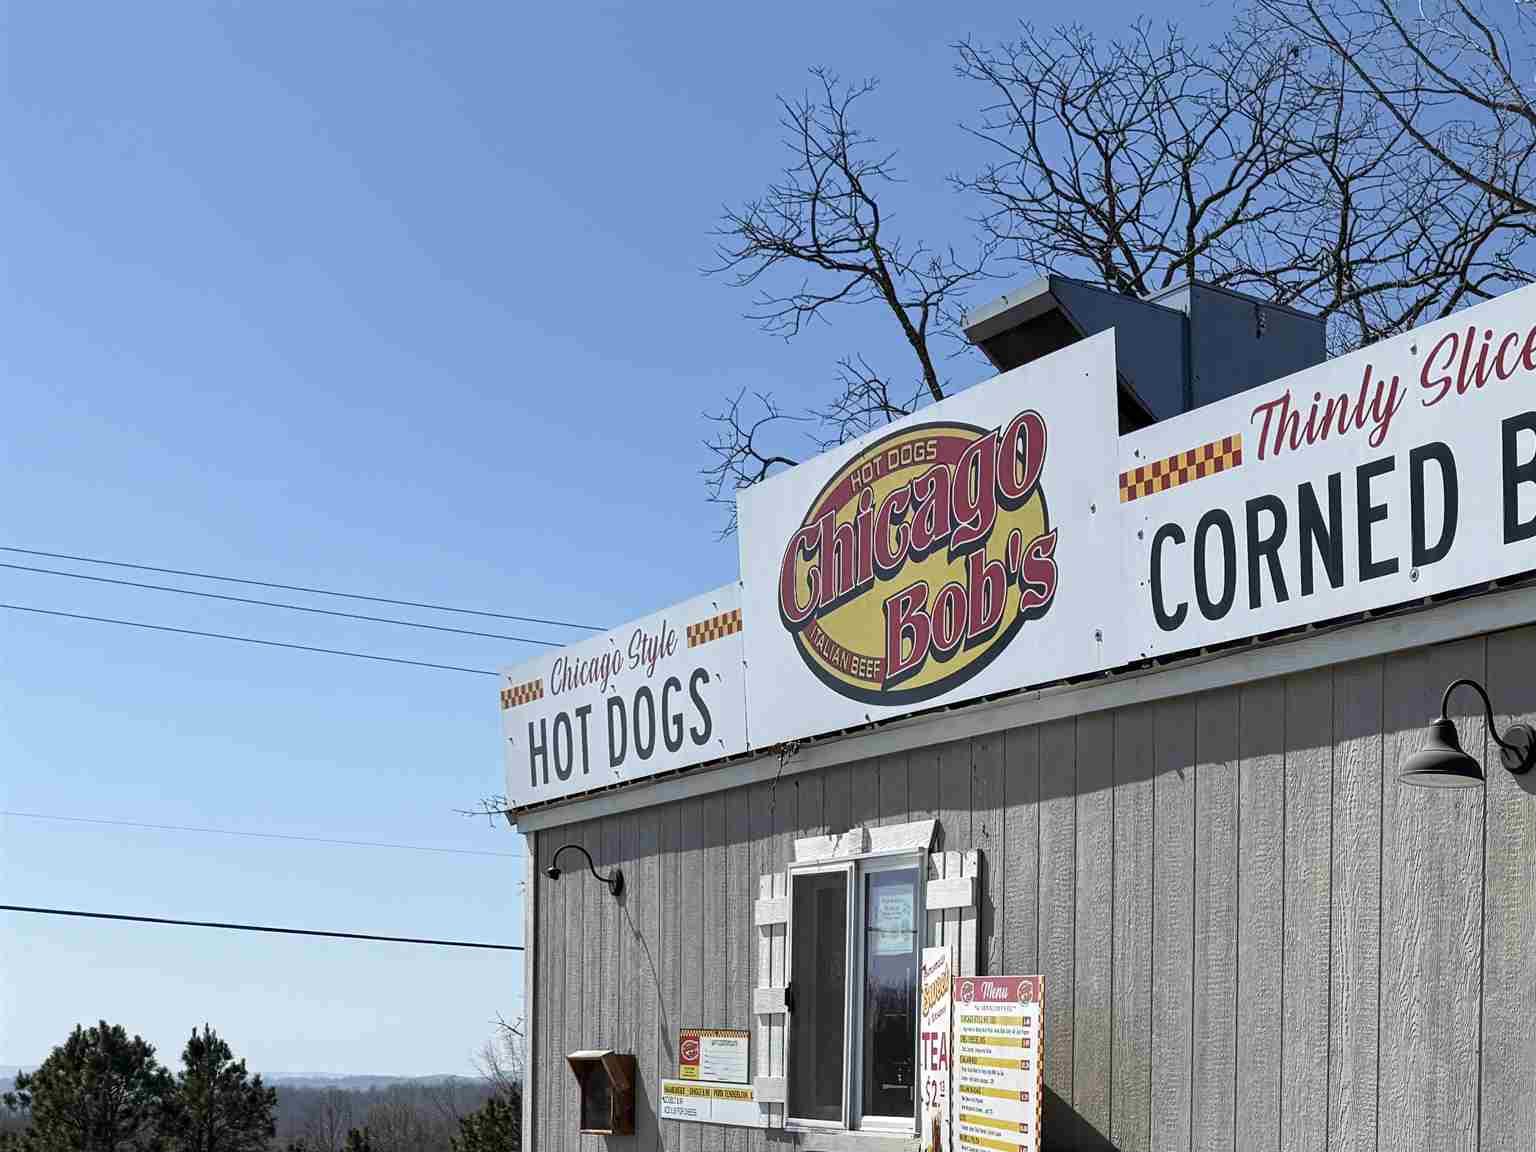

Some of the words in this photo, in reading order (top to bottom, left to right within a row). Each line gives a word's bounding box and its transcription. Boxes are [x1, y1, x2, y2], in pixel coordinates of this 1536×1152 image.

[1251, 364, 1407, 462] Thinly
[850, 458, 886, 492] HOT
[887, 439, 939, 469] DOGS
[778, 408, 1048, 632] Chicago
[1149, 440, 1459, 633] CORNED
[811, 625, 849, 671] ITALIAN
[850, 656, 881, 679] BEEF
[881, 528, 1059, 692] Bob's
[550, 639, 624, 697] Chicago
[626, 620, 678, 676] Style
[527, 703, 592, 788] HOT
[607, 667, 714, 768] DOGS
[980, 981, 1009, 1000] Menu
[922, 1031, 948, 1072] TEA
